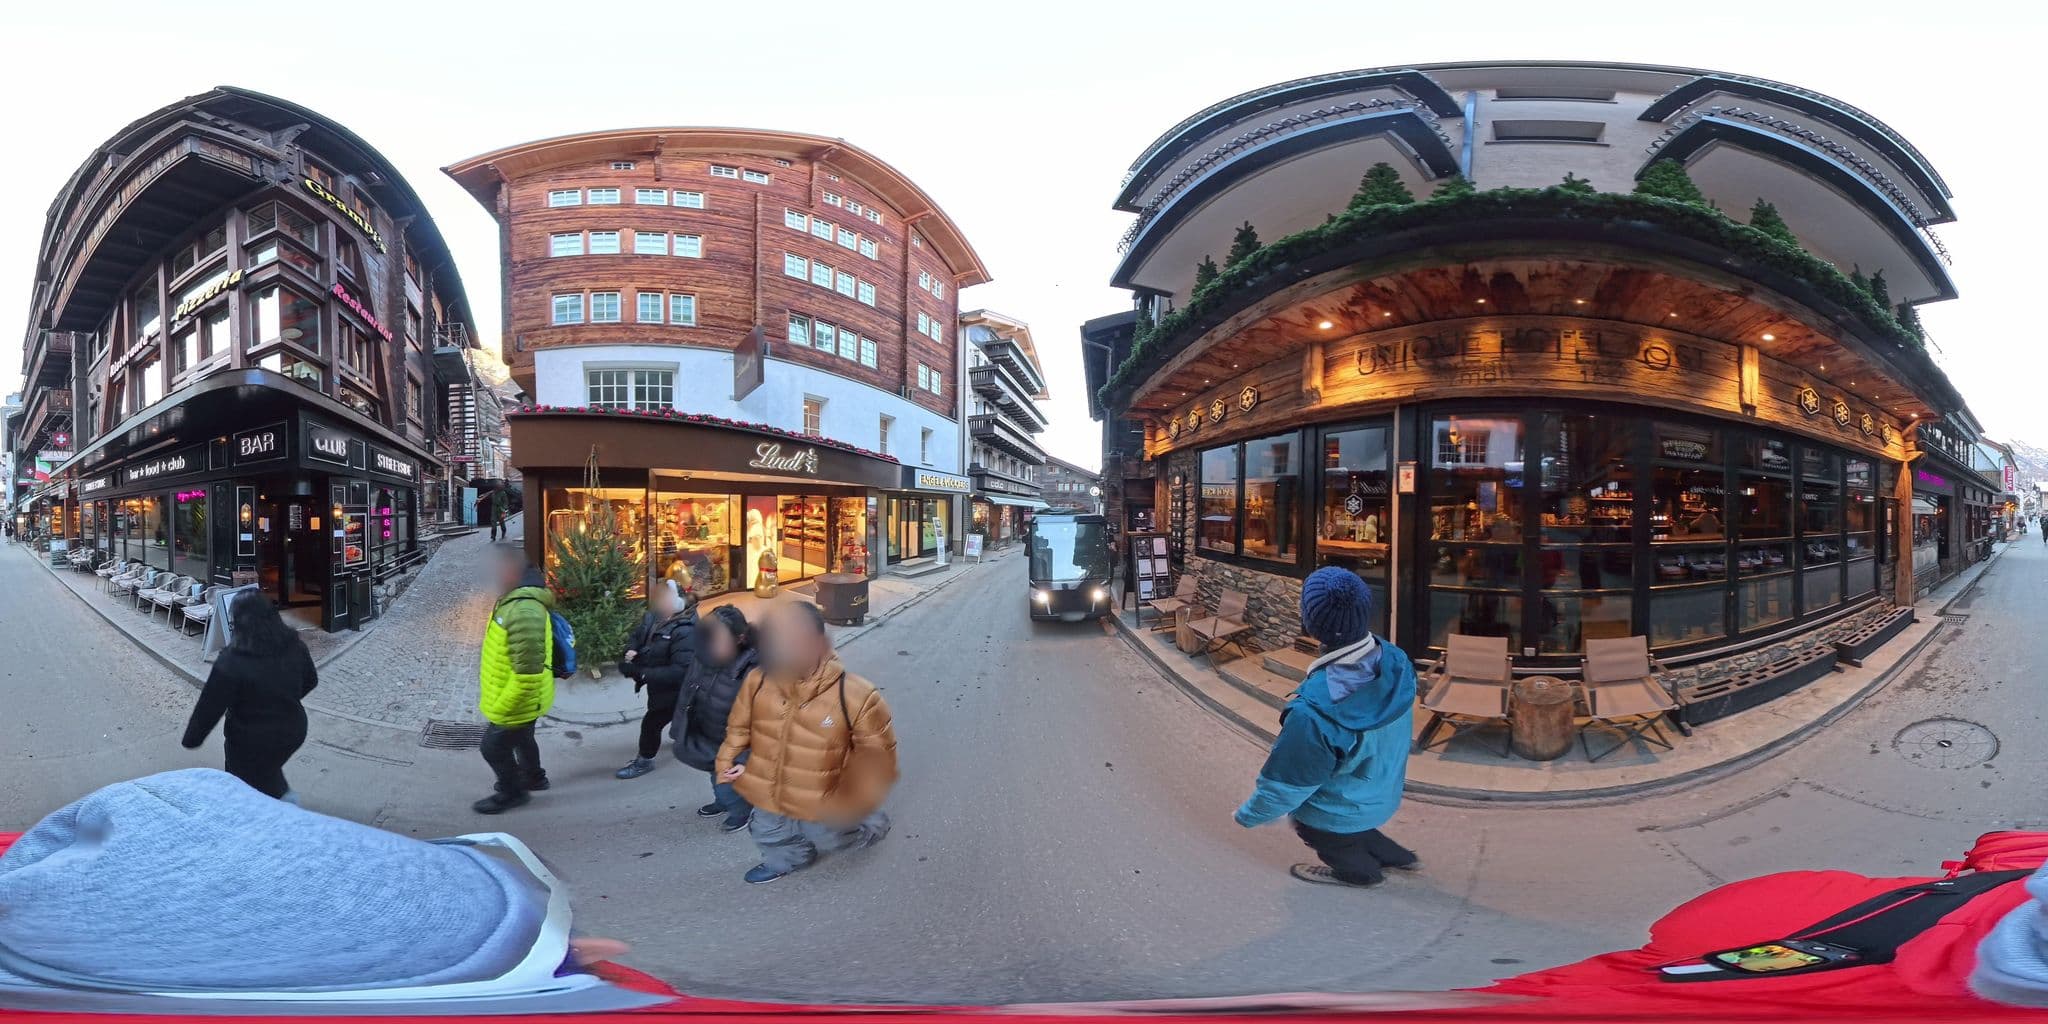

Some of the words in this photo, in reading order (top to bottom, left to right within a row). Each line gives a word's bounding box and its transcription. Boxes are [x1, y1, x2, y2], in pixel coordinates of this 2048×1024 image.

[175, 269, 244, 321] Pizzeria
[332, 282, 393, 343] Restaurant
[110, 335, 150, 377] Ristorante
[240, 432, 274, 456] BAR
[315, 437, 347, 457] CLUB
[749, 442, 806, 471] Lindt
[129, 469, 139, 480] bar
[145, 462, 160, 477] food
[167, 455, 186, 472] club
